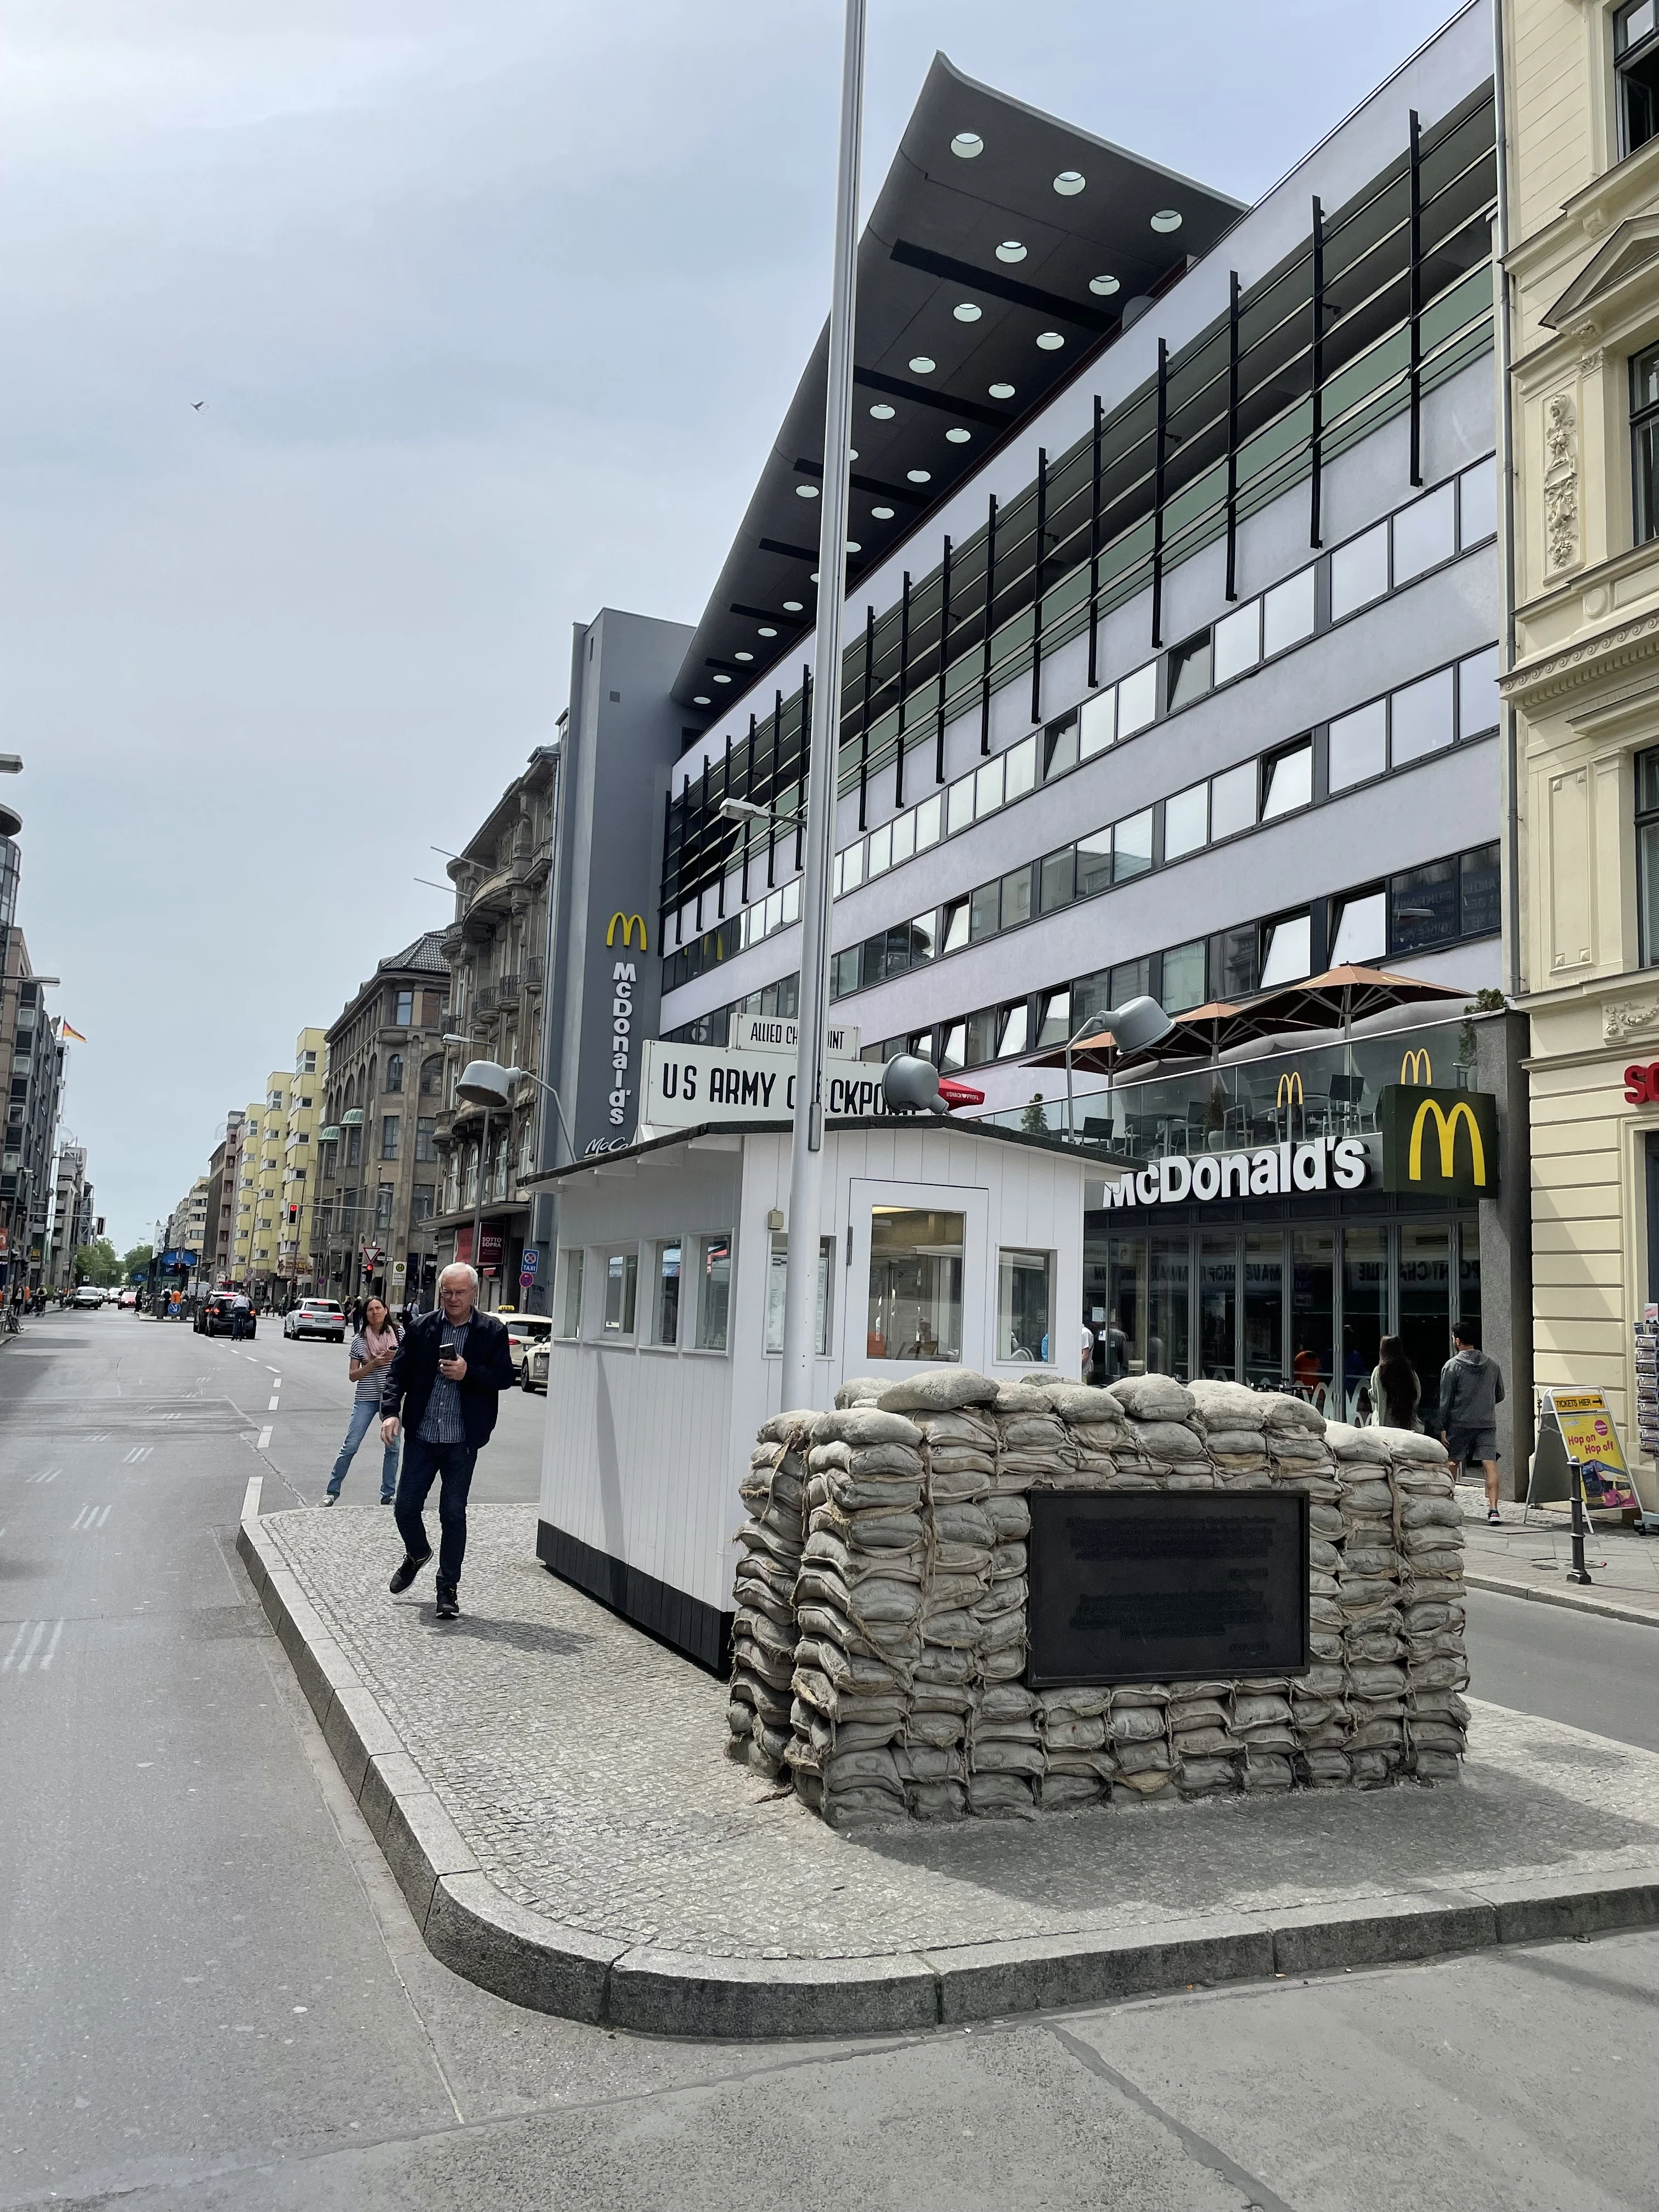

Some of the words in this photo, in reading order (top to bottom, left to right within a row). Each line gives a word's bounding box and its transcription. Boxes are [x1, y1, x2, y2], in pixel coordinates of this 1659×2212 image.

[608, 962, 637, 1125] McDonald's
[750, 1022, 782, 1043] ALLIED
[786, 1026, 845, 1050] CHINT
[663, 1062, 697, 1101] US
[709, 1068, 777, 1108] ARMY
[1102, 1136, 1367, 1208] McDonald's
[1555, 1399, 1578, 1408] TICKETS
[1578, 1398, 1592, 1407] HIER
[1567, 1435, 1584, 1446] Hop
[1586, 1434, 1596, 1443] on
[1584, 1444, 1601, 1454] Hop
[1602, 1441, 1614, 1451] off
